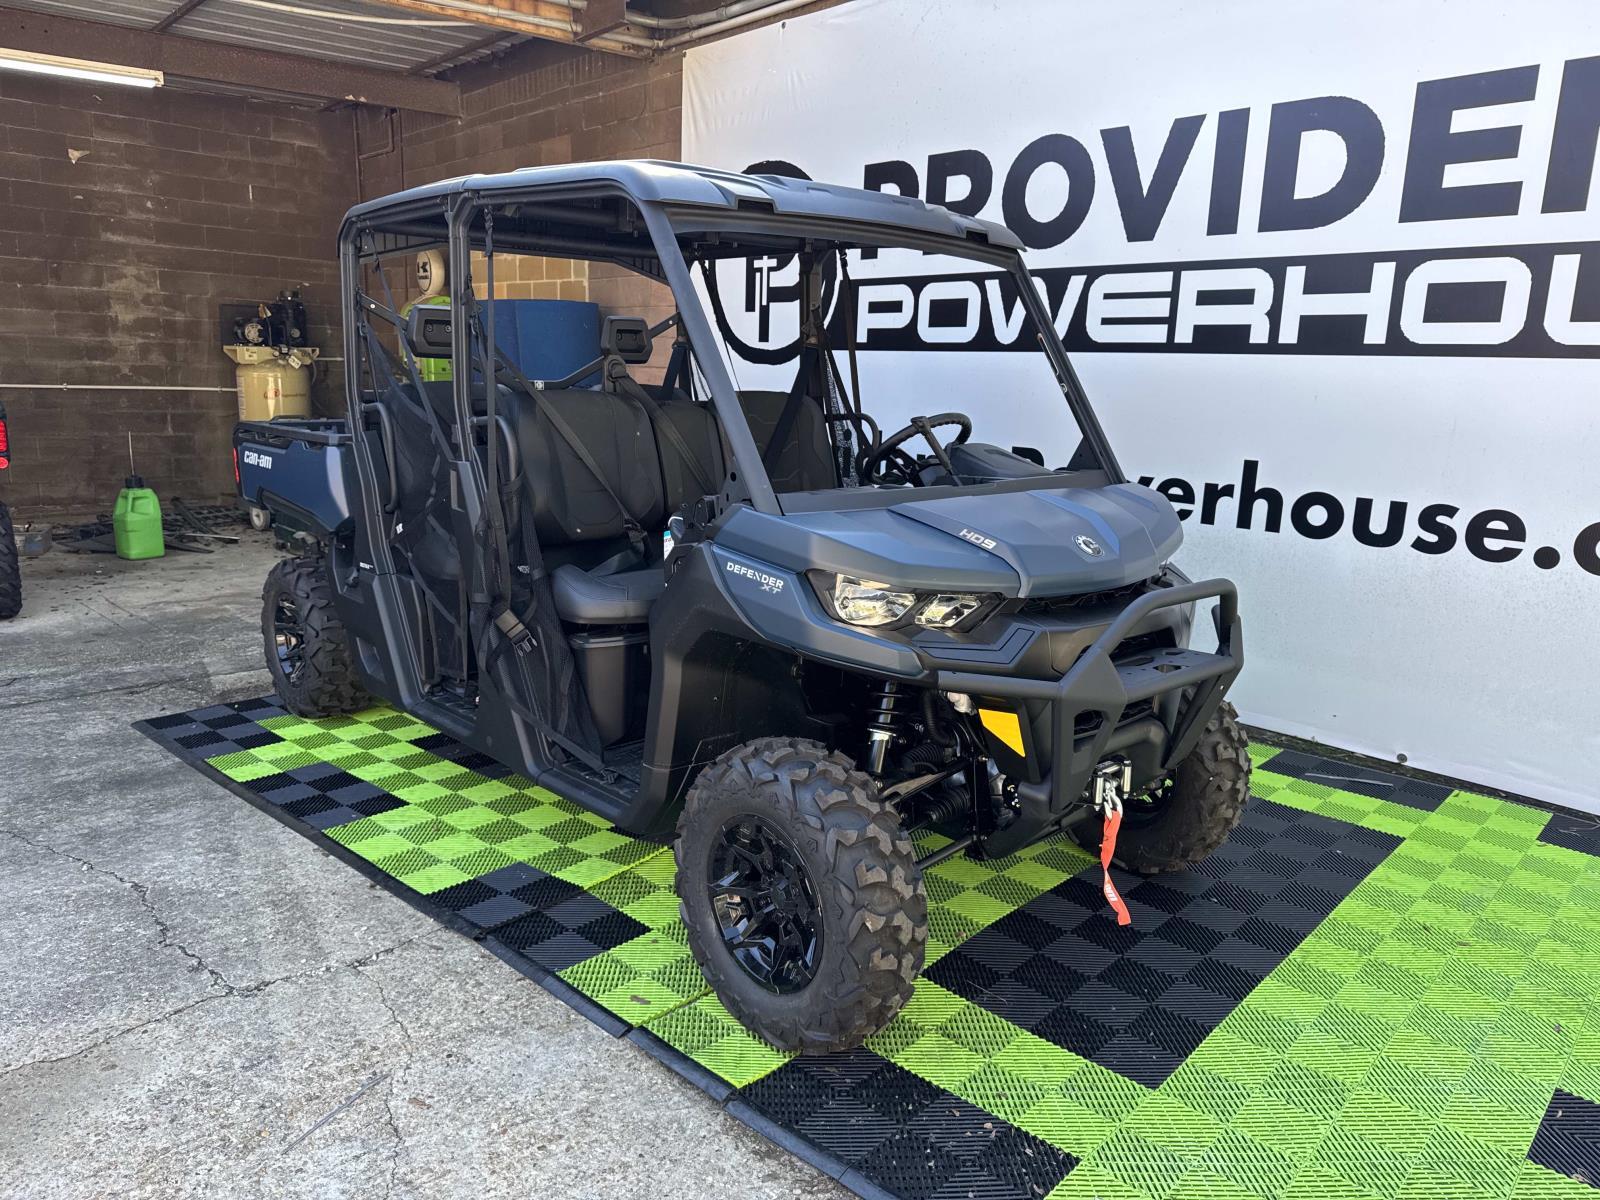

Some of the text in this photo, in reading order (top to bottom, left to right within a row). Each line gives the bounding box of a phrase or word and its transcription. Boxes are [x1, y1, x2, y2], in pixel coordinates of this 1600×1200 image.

[243, 450, 273, 470] can-am
[959, 528, 998, 550] HD9
[726, 561, 785, 590] DEFENDER
[761, 583, 782, 595] XT
